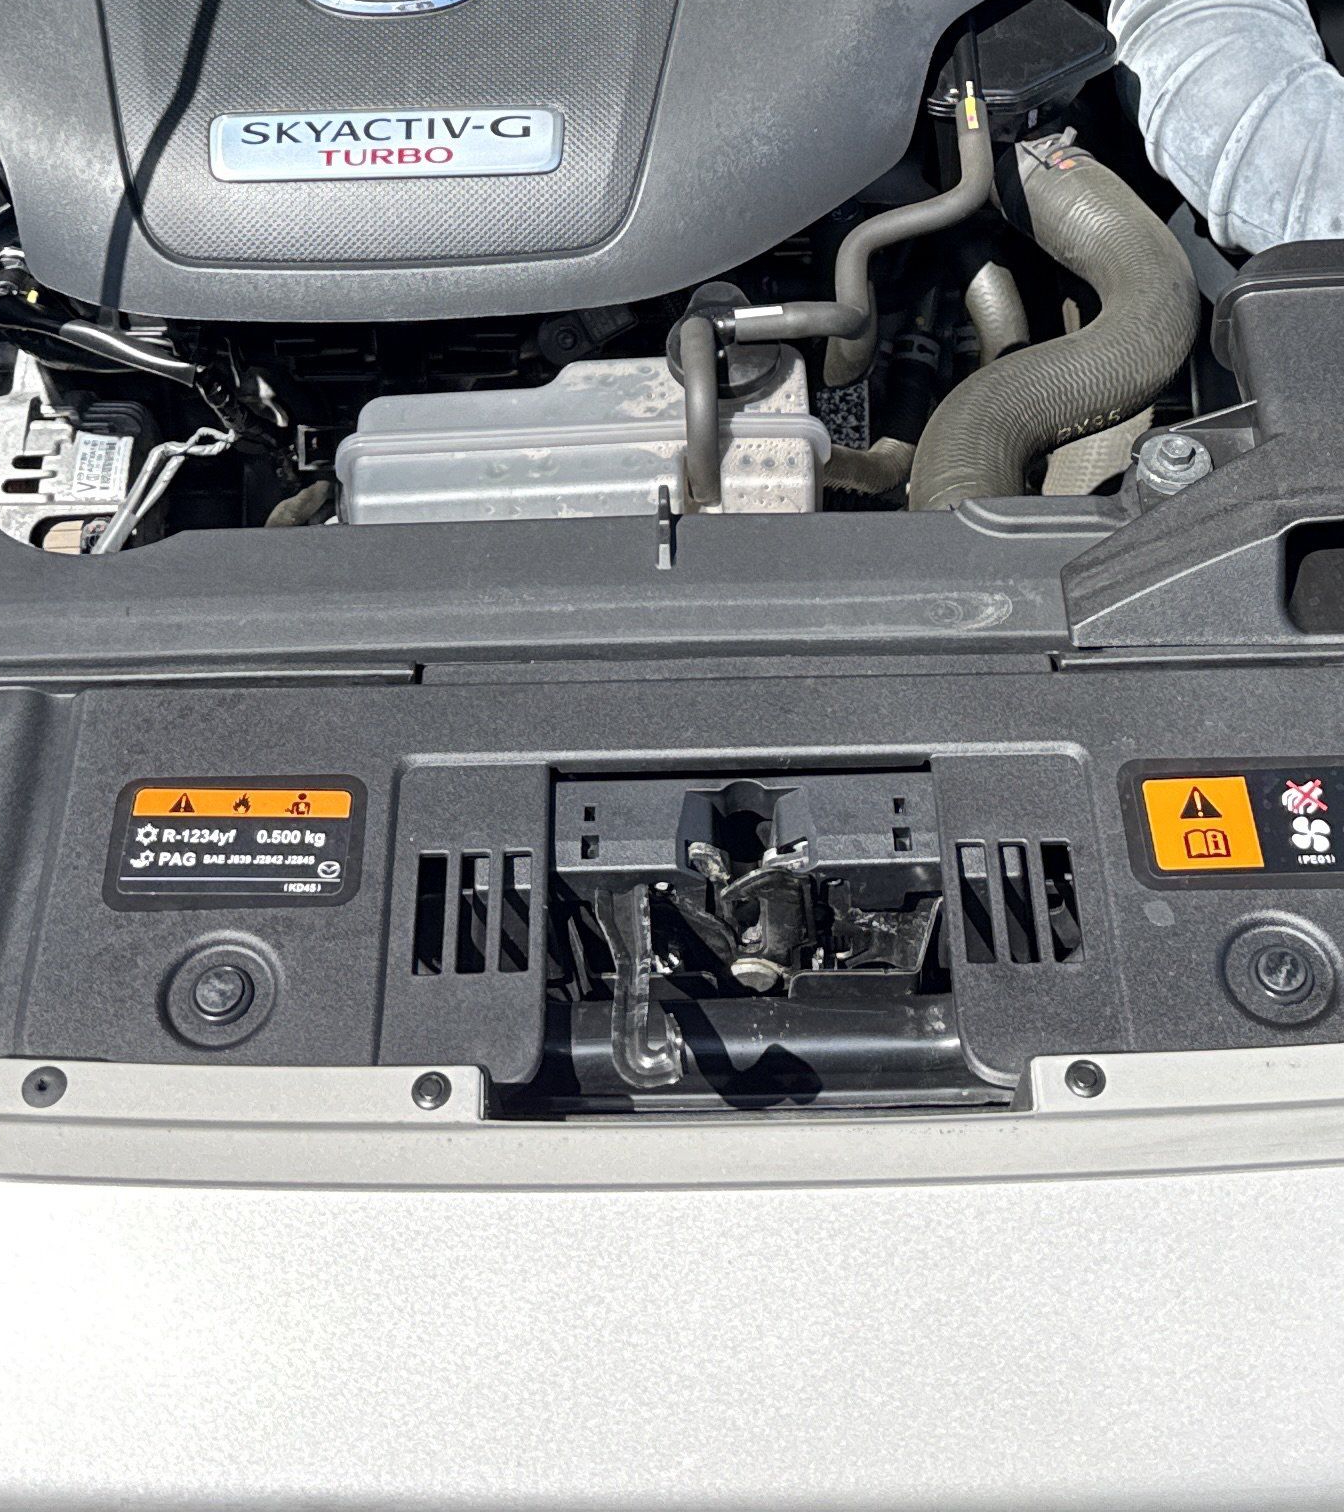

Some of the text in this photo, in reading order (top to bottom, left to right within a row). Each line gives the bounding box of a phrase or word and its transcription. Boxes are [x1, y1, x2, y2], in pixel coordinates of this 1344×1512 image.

[241, 115, 532, 145] SKYACTIV-G
[318, 146, 454, 167] TURBO
[162, 828, 326, 847] R-1234yf 0.500 kg
[158, 852, 197, 867] PAG
[202, 854, 226, 865] SAE
[227, 854, 252, 865] J639
